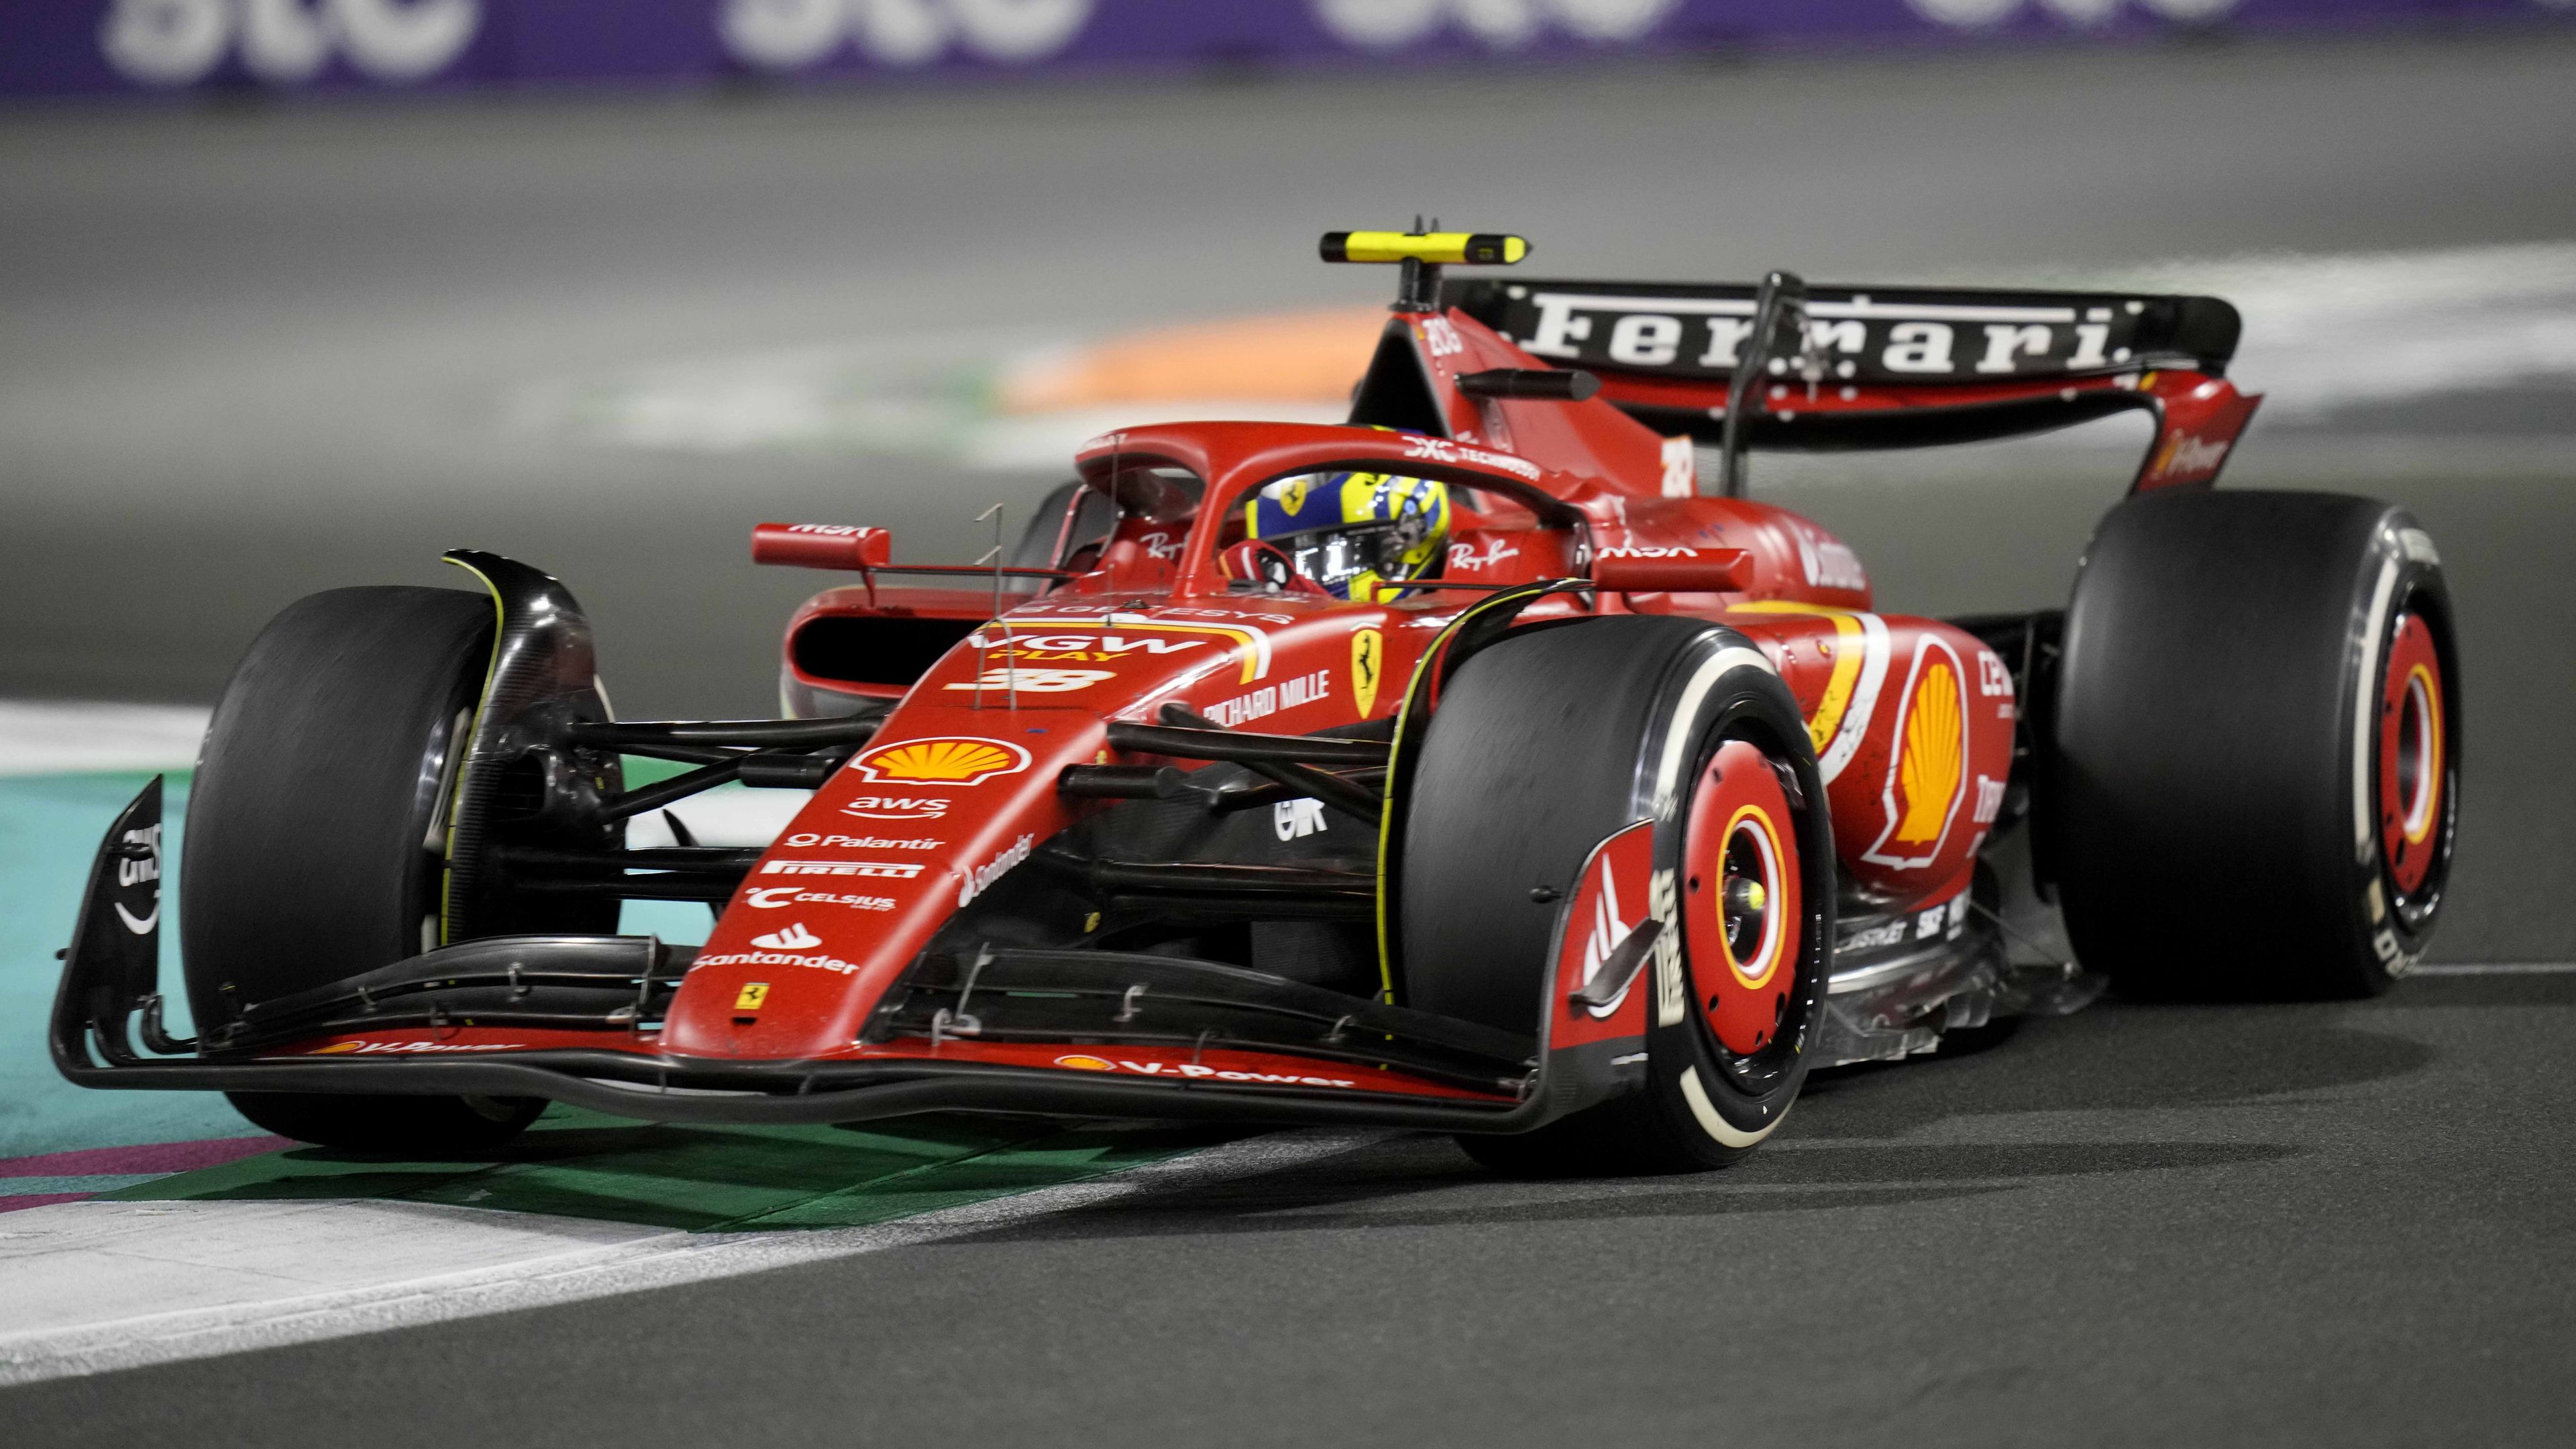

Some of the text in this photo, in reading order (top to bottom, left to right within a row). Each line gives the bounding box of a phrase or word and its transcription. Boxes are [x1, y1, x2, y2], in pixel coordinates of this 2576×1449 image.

[1057, 605, 1295, 625] GEESYS
[967, 635, 1208, 653] VGW
[987, 649, 1132, 661] PLAY
[943, 668, 1118, 692] 38
[1279, 669, 1330, 710] MILLE
[847, 796, 952, 811] aws
[820, 835, 946, 850] Palantir
[759, 860, 926, 879] PIRELLI
[794, 893, 897, 908] CELSIUS
[688, 951, 860, 975] Santander
[353, 1040, 525, 1053] V-Power
[1118, 1061, 1355, 1087] V-Power
